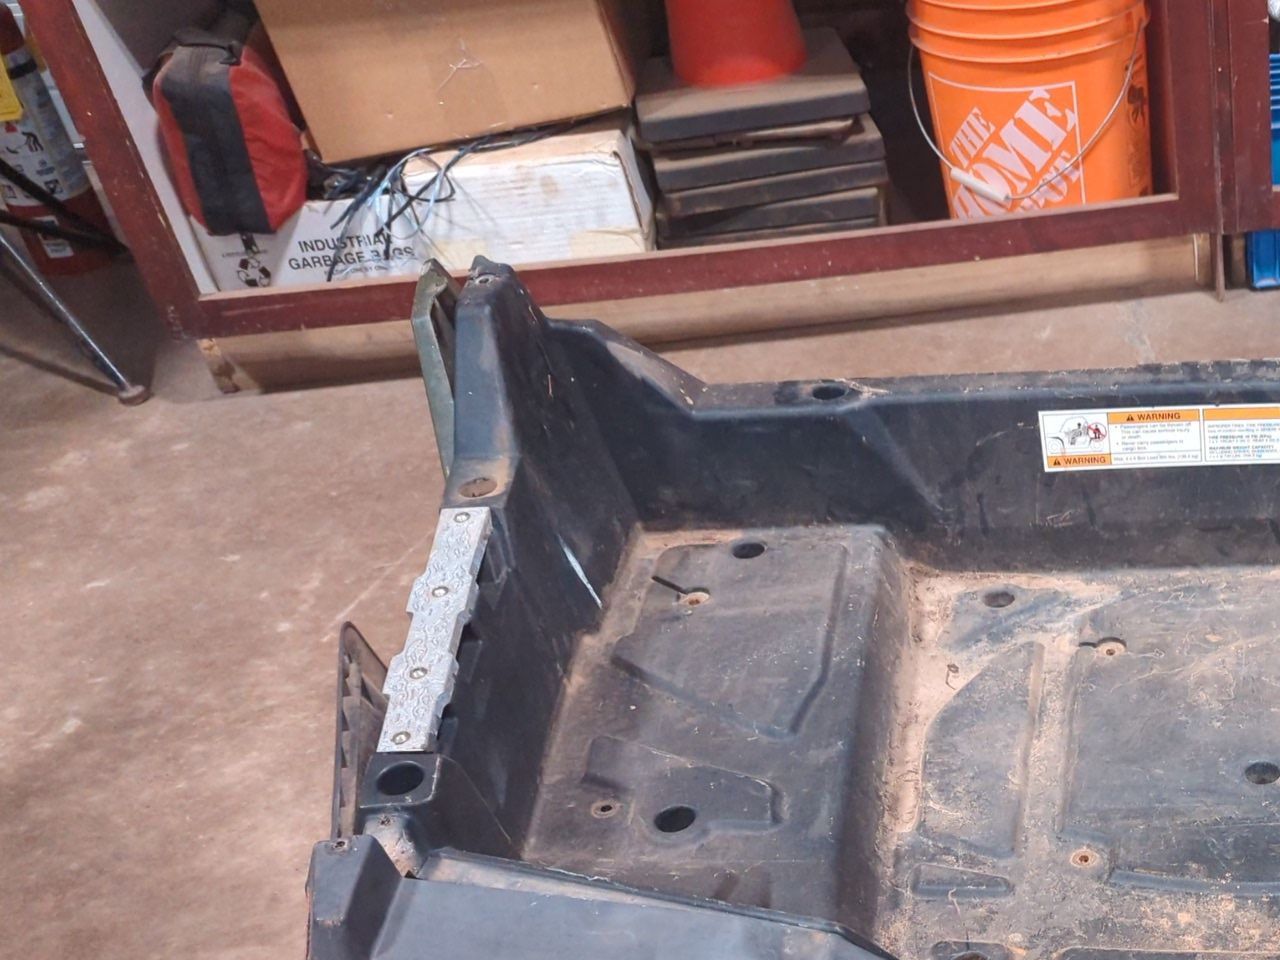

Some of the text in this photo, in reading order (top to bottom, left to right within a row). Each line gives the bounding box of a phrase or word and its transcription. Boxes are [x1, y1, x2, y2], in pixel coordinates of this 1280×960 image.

[949, 107, 996, 168] THE
[952, 87, 1077, 218] HOME
[1137, 413, 1181, 422] WARNING
[1063, 457, 1106, 465] WARNING
